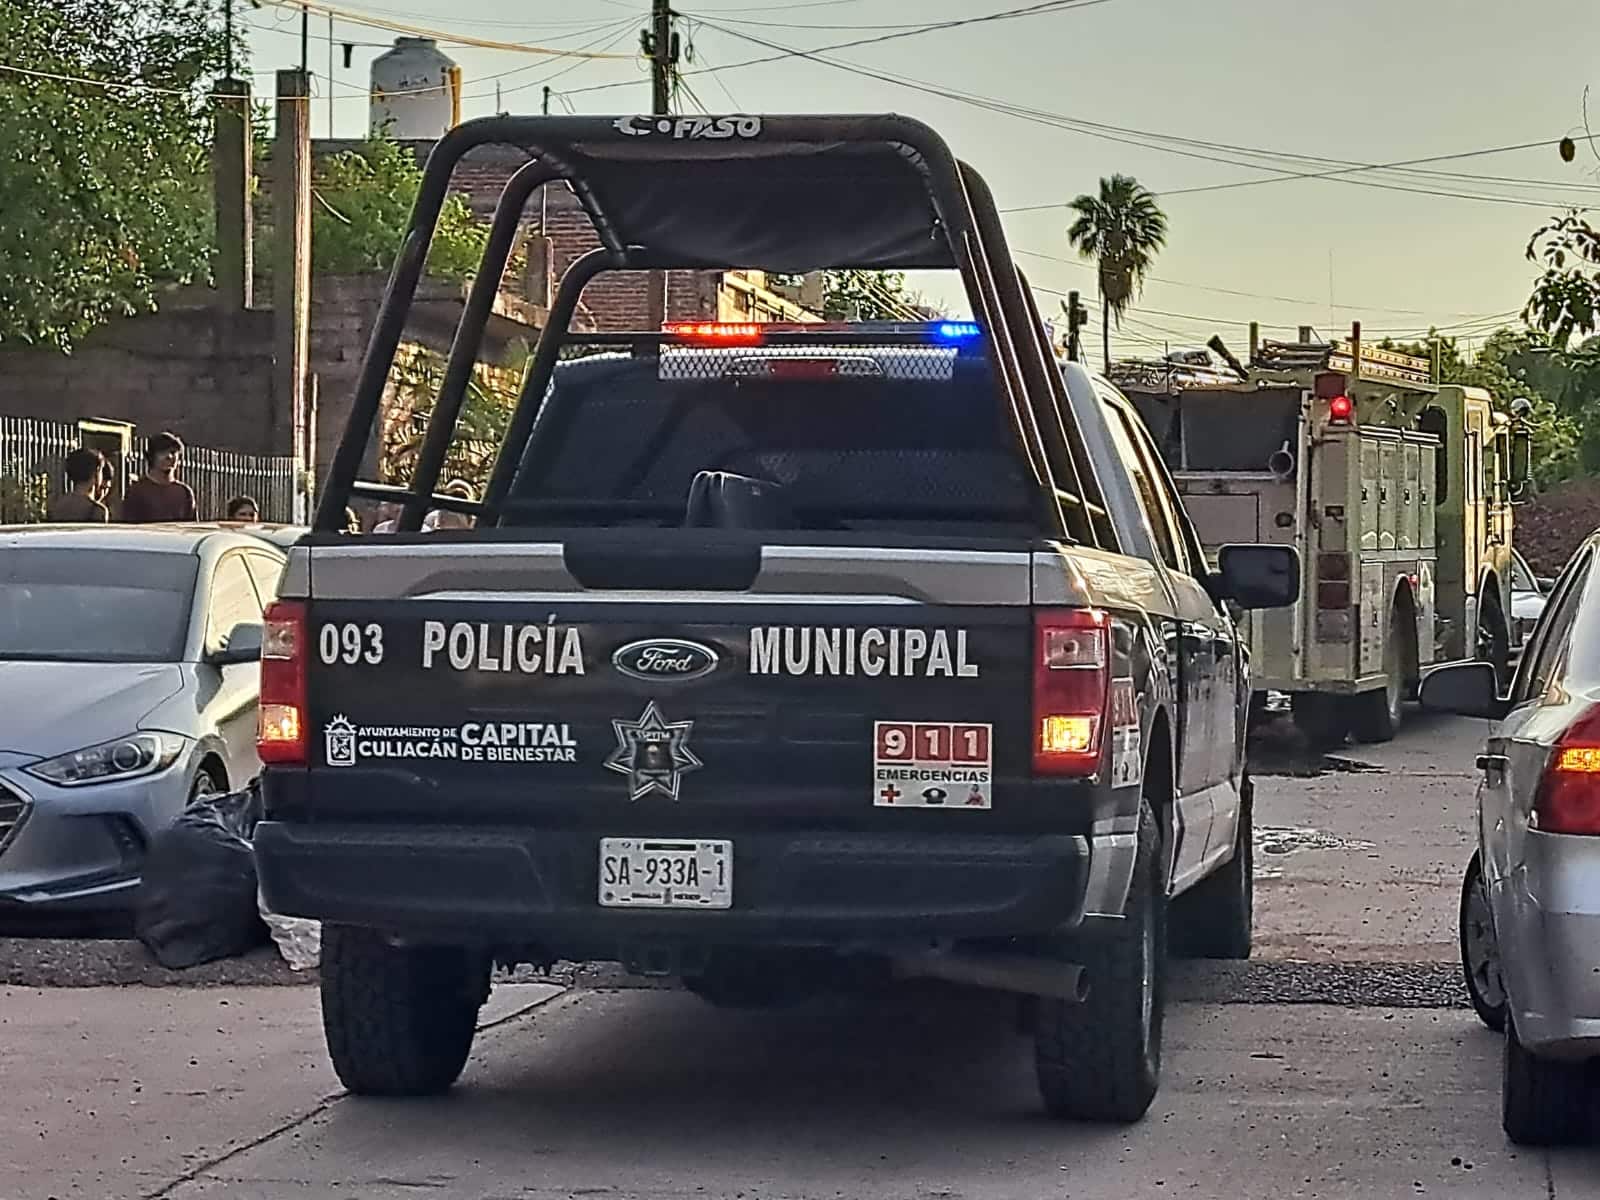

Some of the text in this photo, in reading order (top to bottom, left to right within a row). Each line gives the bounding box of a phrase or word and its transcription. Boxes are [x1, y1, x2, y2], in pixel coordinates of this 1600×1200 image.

[319, 623, 384, 665] 093
[422, 614, 979, 677] POLICÍA MUNICIPAL
[636, 647, 692, 673] Ford
[358, 727, 457, 738] AYUNTAMIENTO DE
[460, 723, 577, 747] CAPITAL
[358, 738, 457, 758] CULIACÁN
[461, 747, 577, 762] DE BIENESTAR
[877, 768, 989, 783] EMERGENCIAS
[604, 856, 724, 887] SA-933A-1
